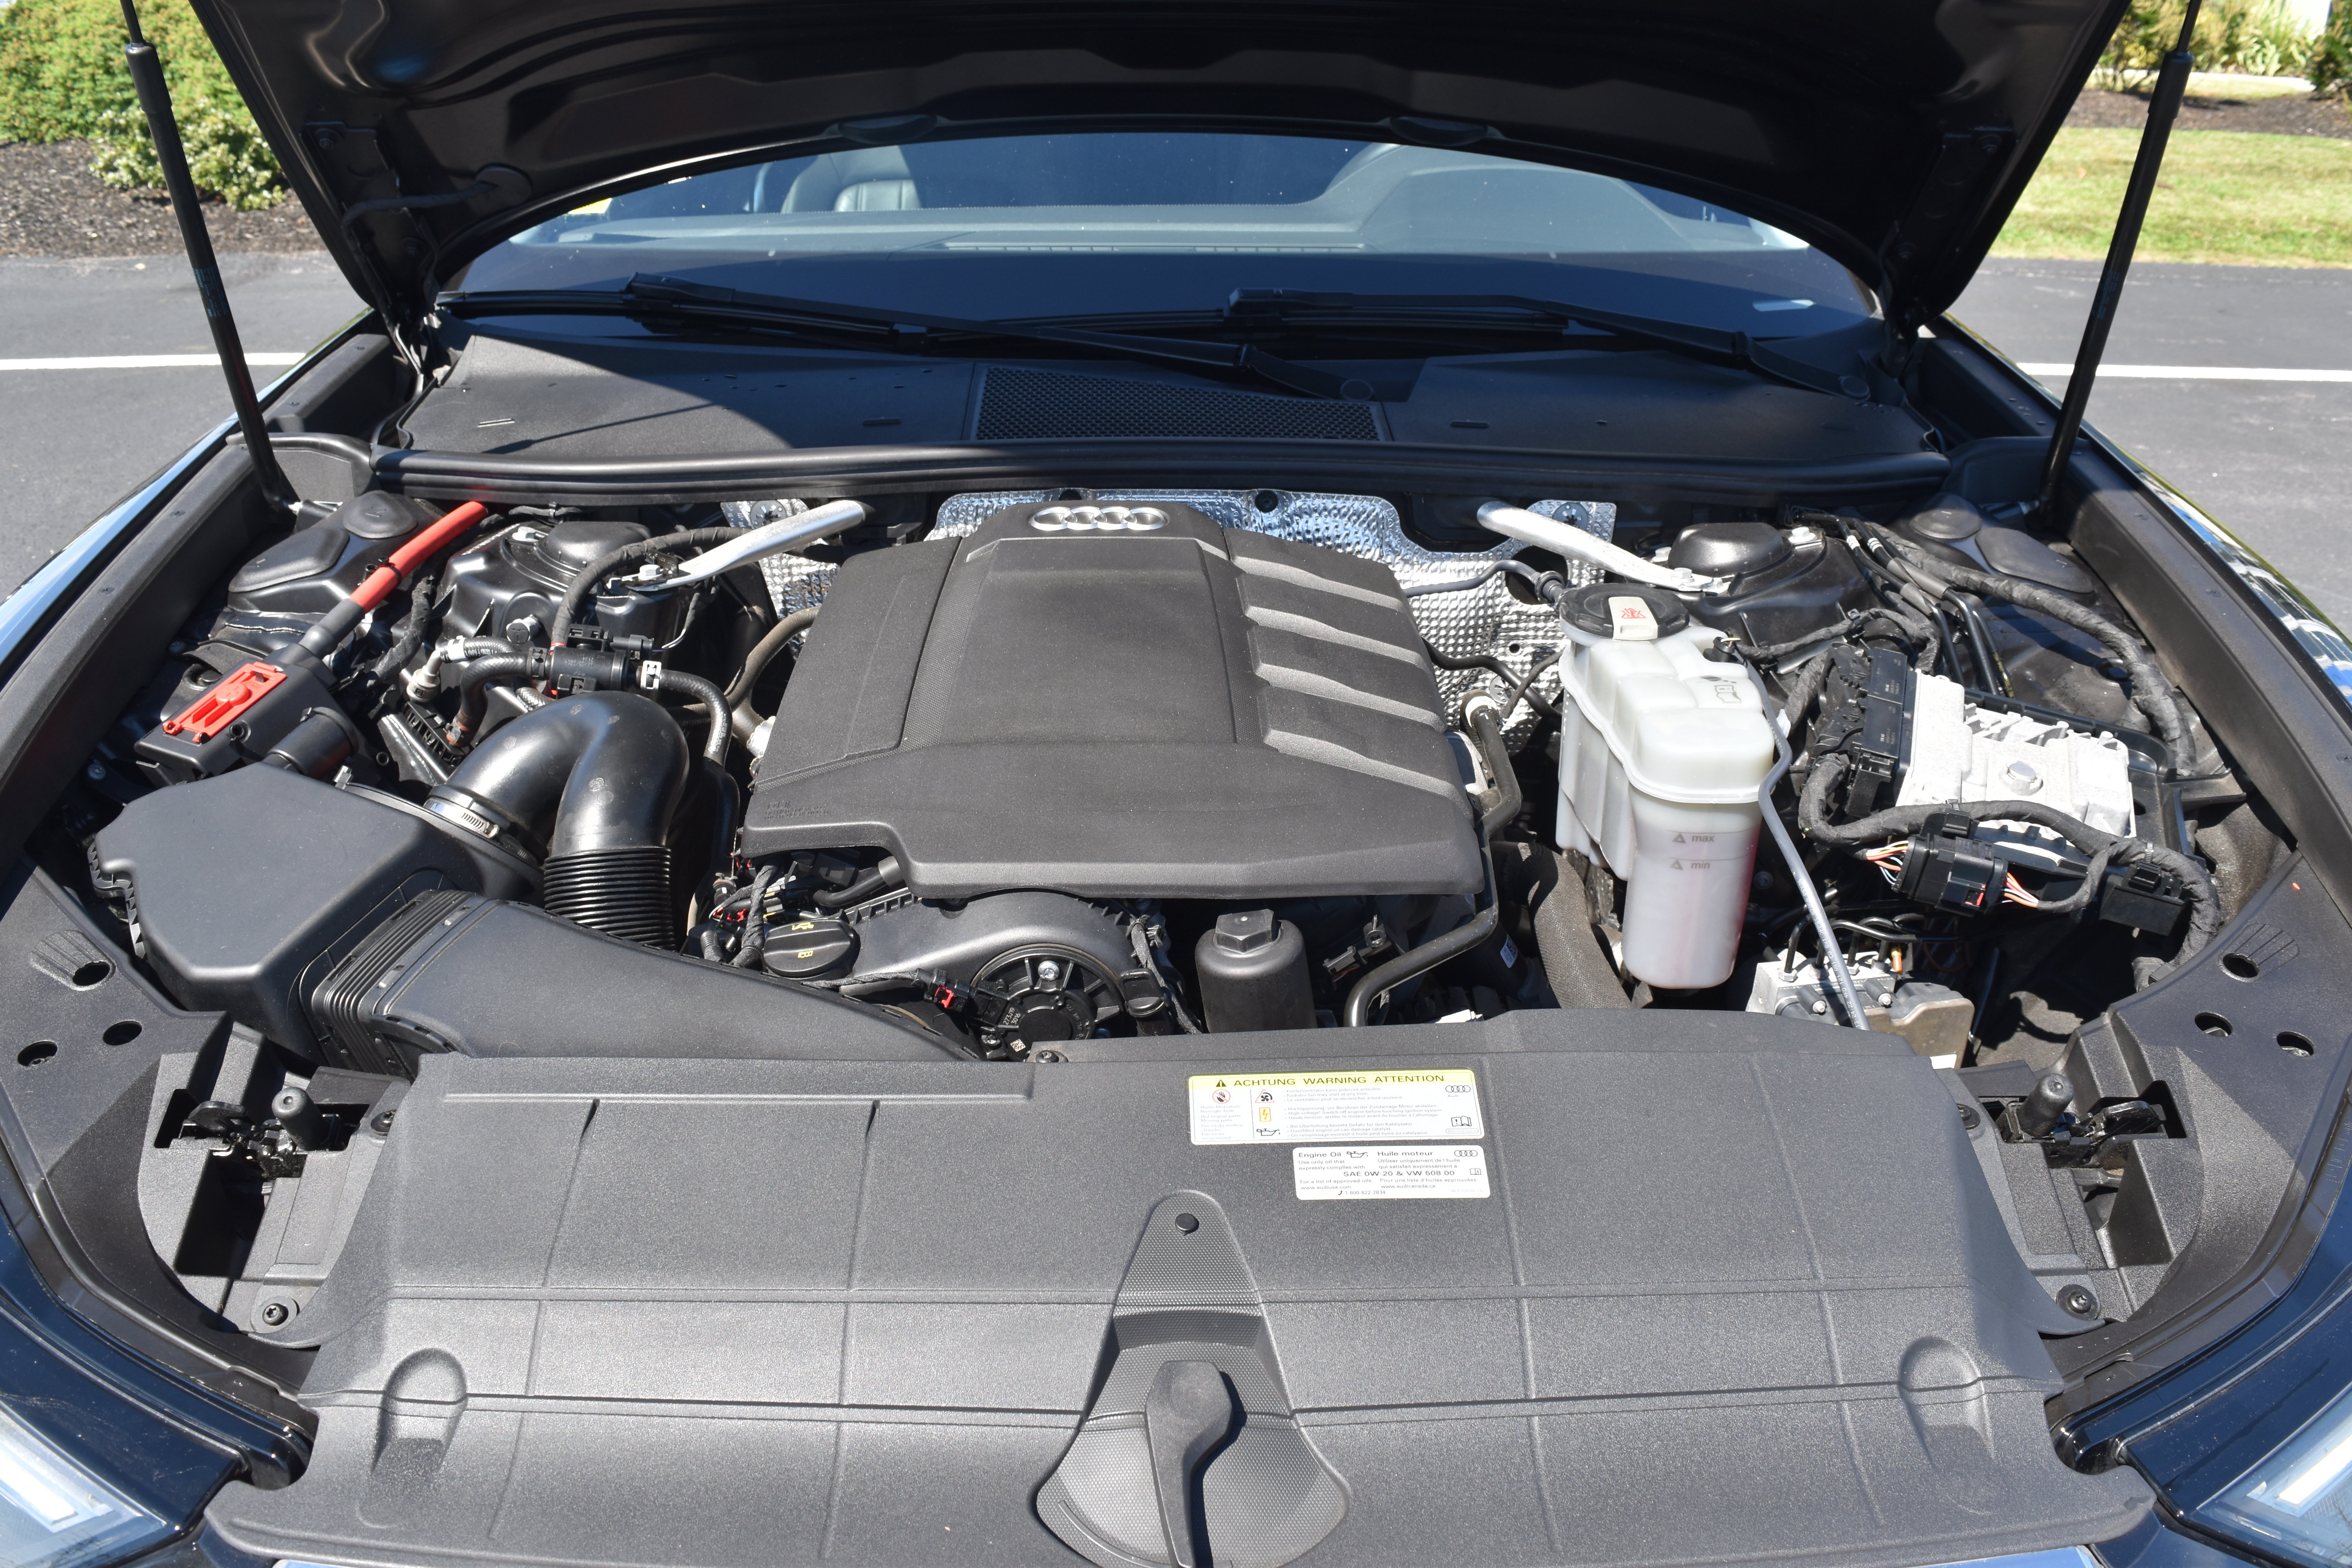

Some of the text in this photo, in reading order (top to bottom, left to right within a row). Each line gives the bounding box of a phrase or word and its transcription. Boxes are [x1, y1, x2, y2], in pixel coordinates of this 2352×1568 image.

[1842, 987, 1850, 999] 4K0
[1003, 1007, 1015, 1025] 273J19
[1011, 1013, 1021, 1025] 3016
[1846, 1000, 1860, 1028] 13:24:22
